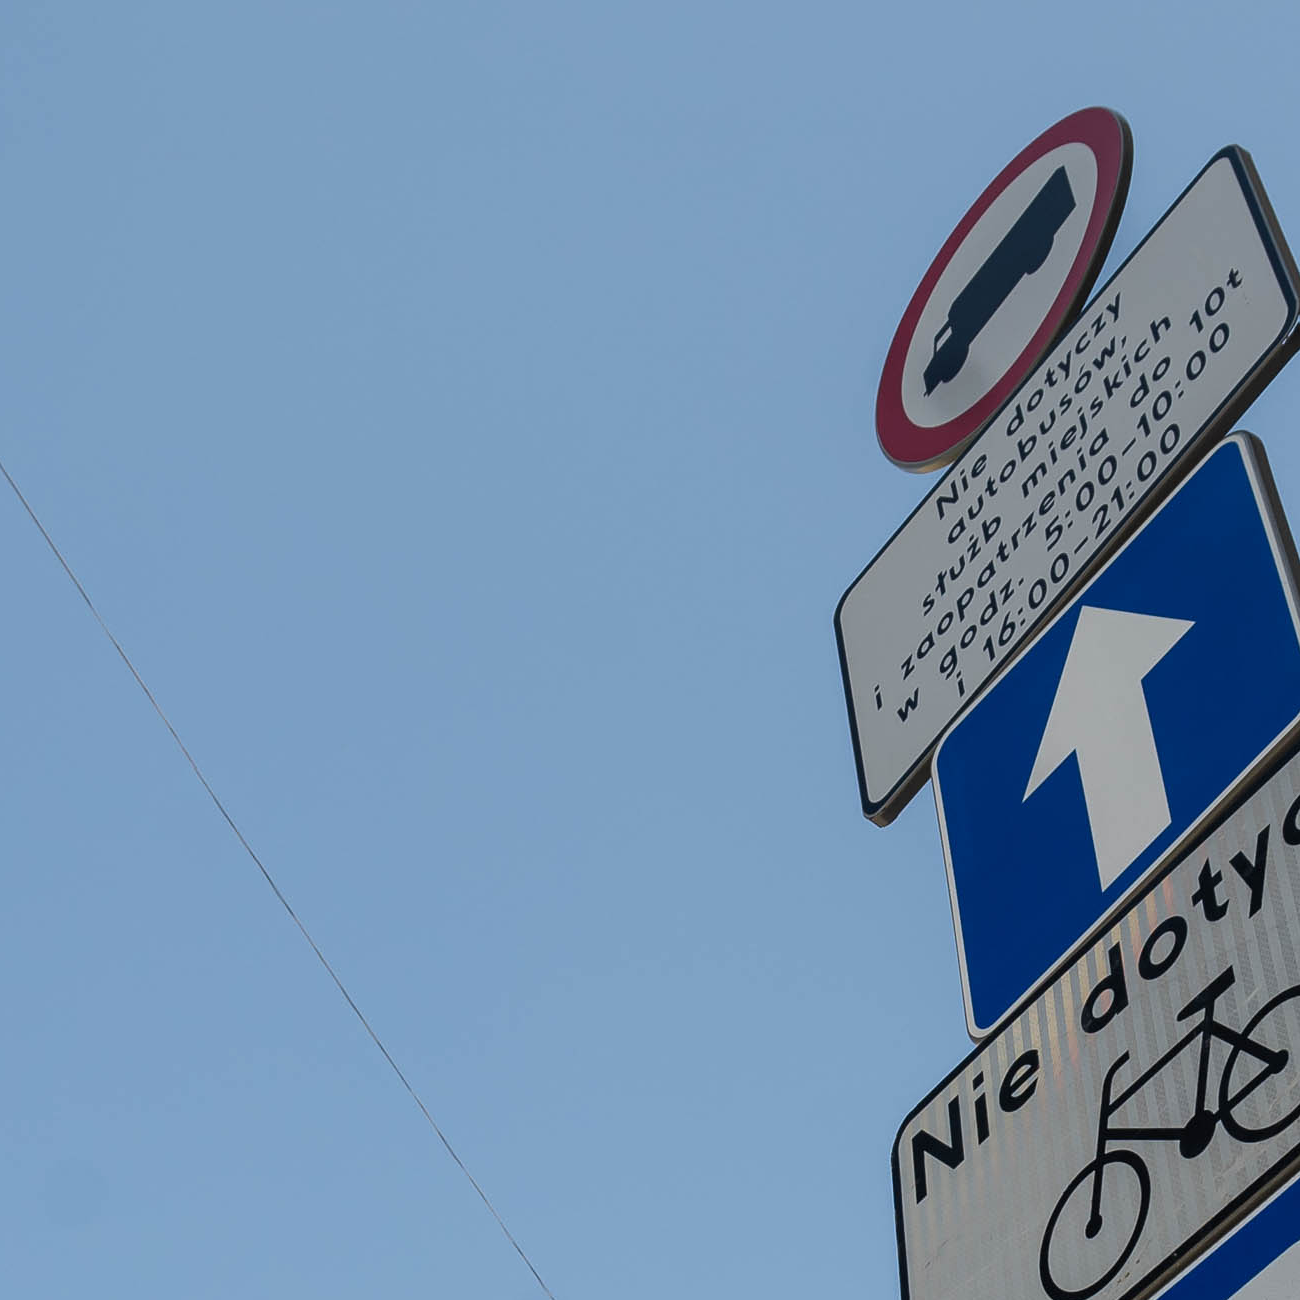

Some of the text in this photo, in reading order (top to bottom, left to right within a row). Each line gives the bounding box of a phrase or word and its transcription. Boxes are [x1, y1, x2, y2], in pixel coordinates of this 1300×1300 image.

[873, 267, 1244, 712] i zaopatrzenia do 10t
[921, 315, 1172, 618] służb miejskich
[935, 291, 1122, 521] Nie dotyczy
[946, 334, 1128, 546] autobusów,
[895, 686, 920, 724] w
[938, 576, 1025, 682] godz.
[955, 669, 967, 699] i
[910, 1048, 1041, 1203] Nie
